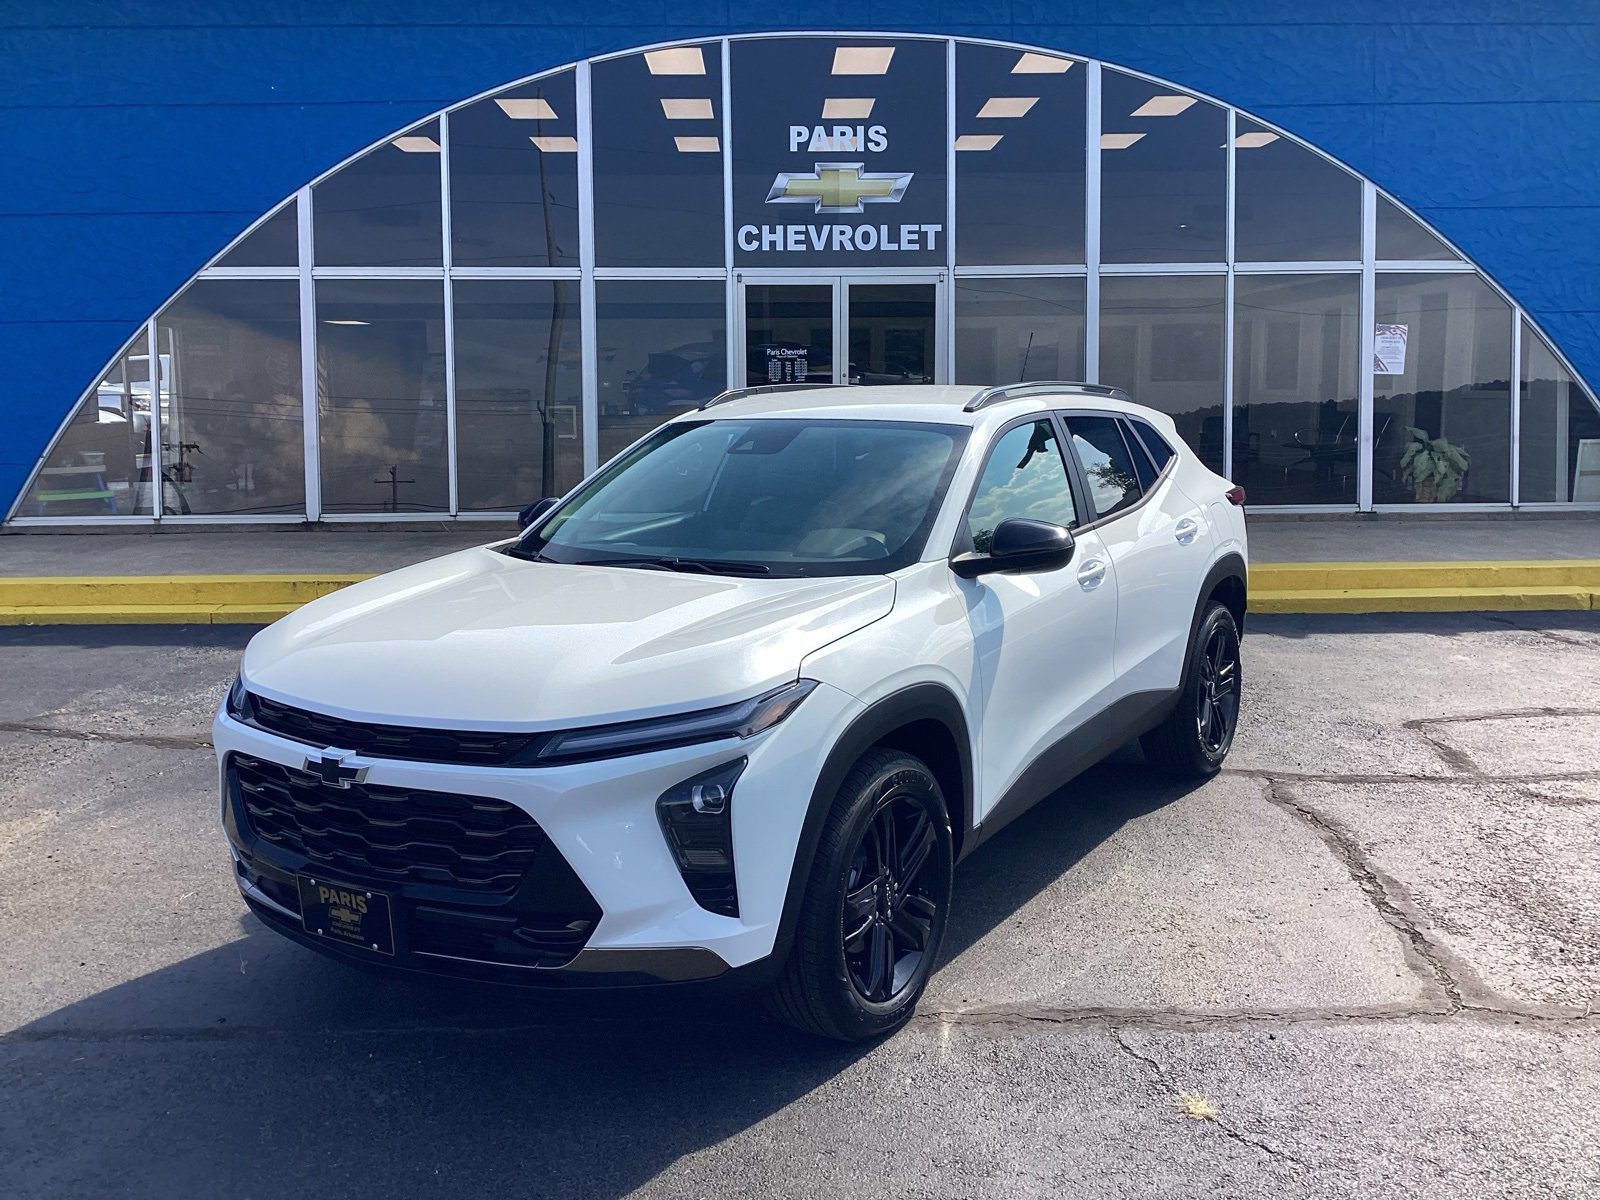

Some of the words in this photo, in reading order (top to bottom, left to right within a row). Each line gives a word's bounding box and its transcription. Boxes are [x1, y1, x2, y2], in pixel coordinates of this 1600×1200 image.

[789, 125, 888, 152] PARIS
[737, 224, 942, 251] CHEVROLET
[318, 886, 368, 914] PARIS
